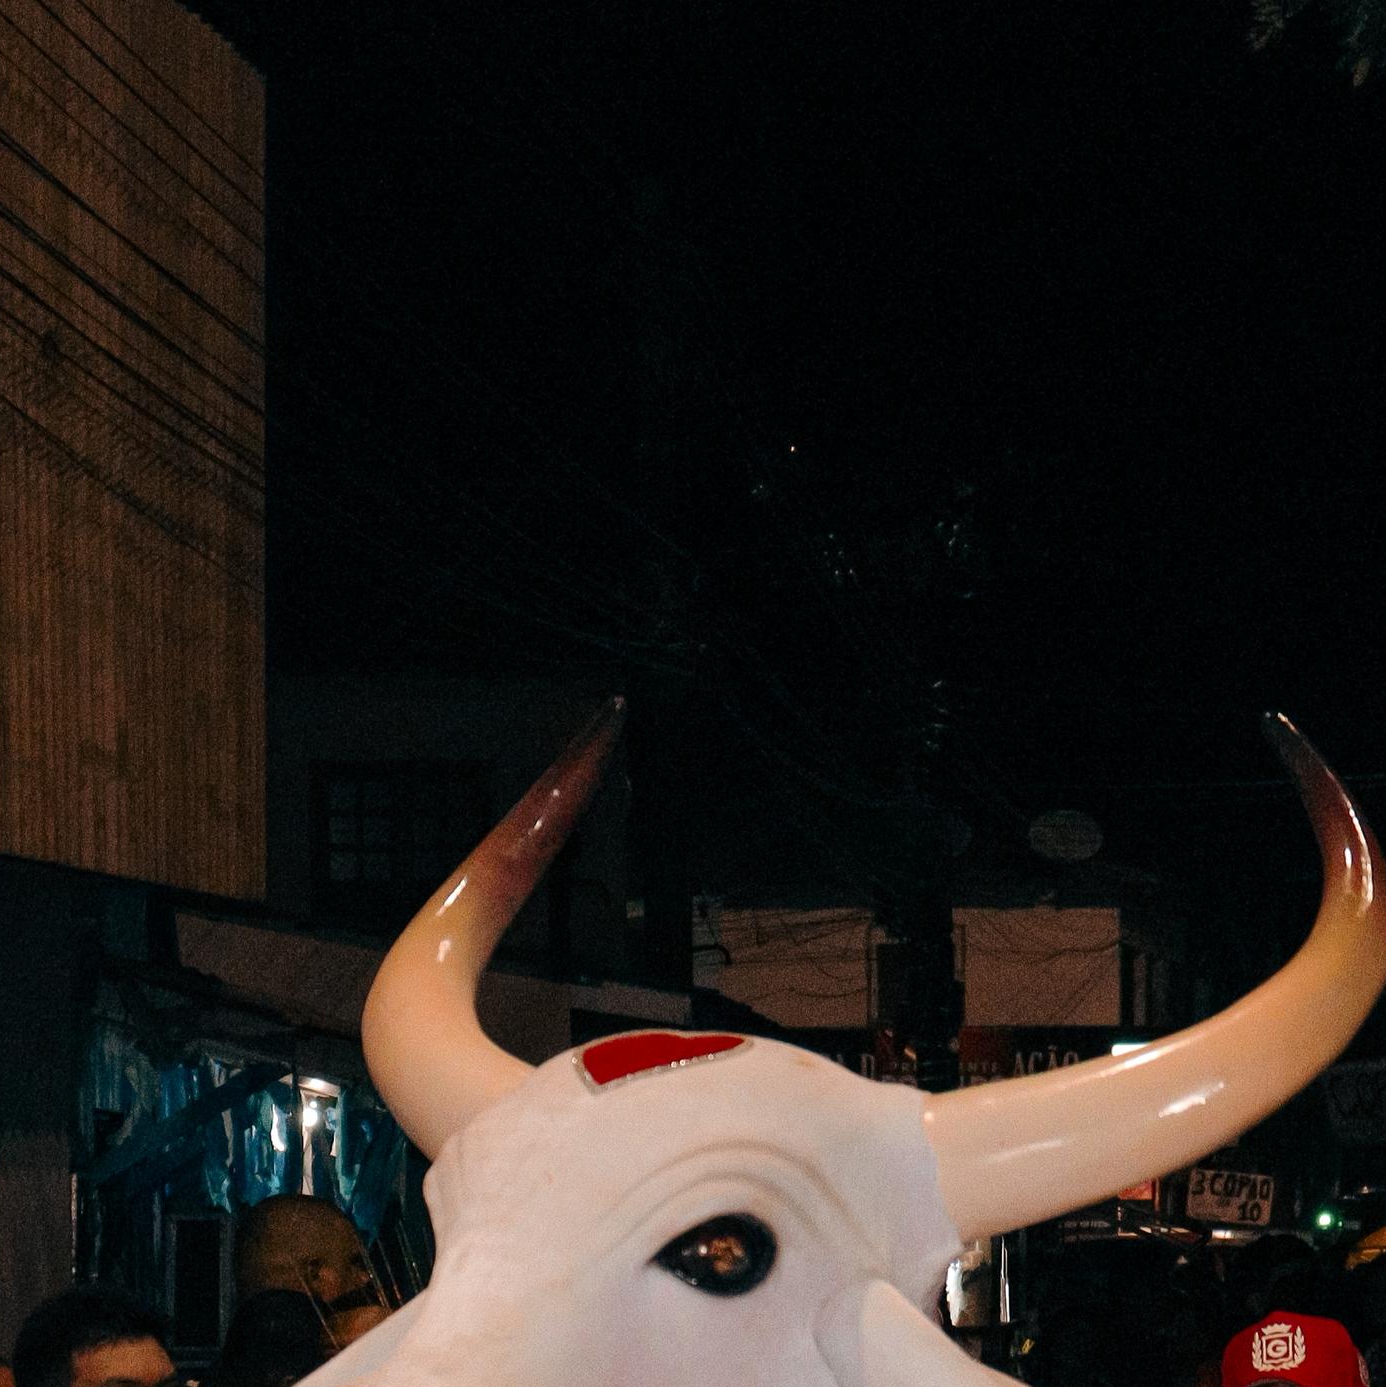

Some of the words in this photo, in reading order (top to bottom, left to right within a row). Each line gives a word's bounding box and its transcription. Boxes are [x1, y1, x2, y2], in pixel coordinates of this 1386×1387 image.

[1191, 1171, 1207, 1195] 3
[1238, 1201, 1262, 1222] 10
[1267, 1339, 1288, 1358] G
